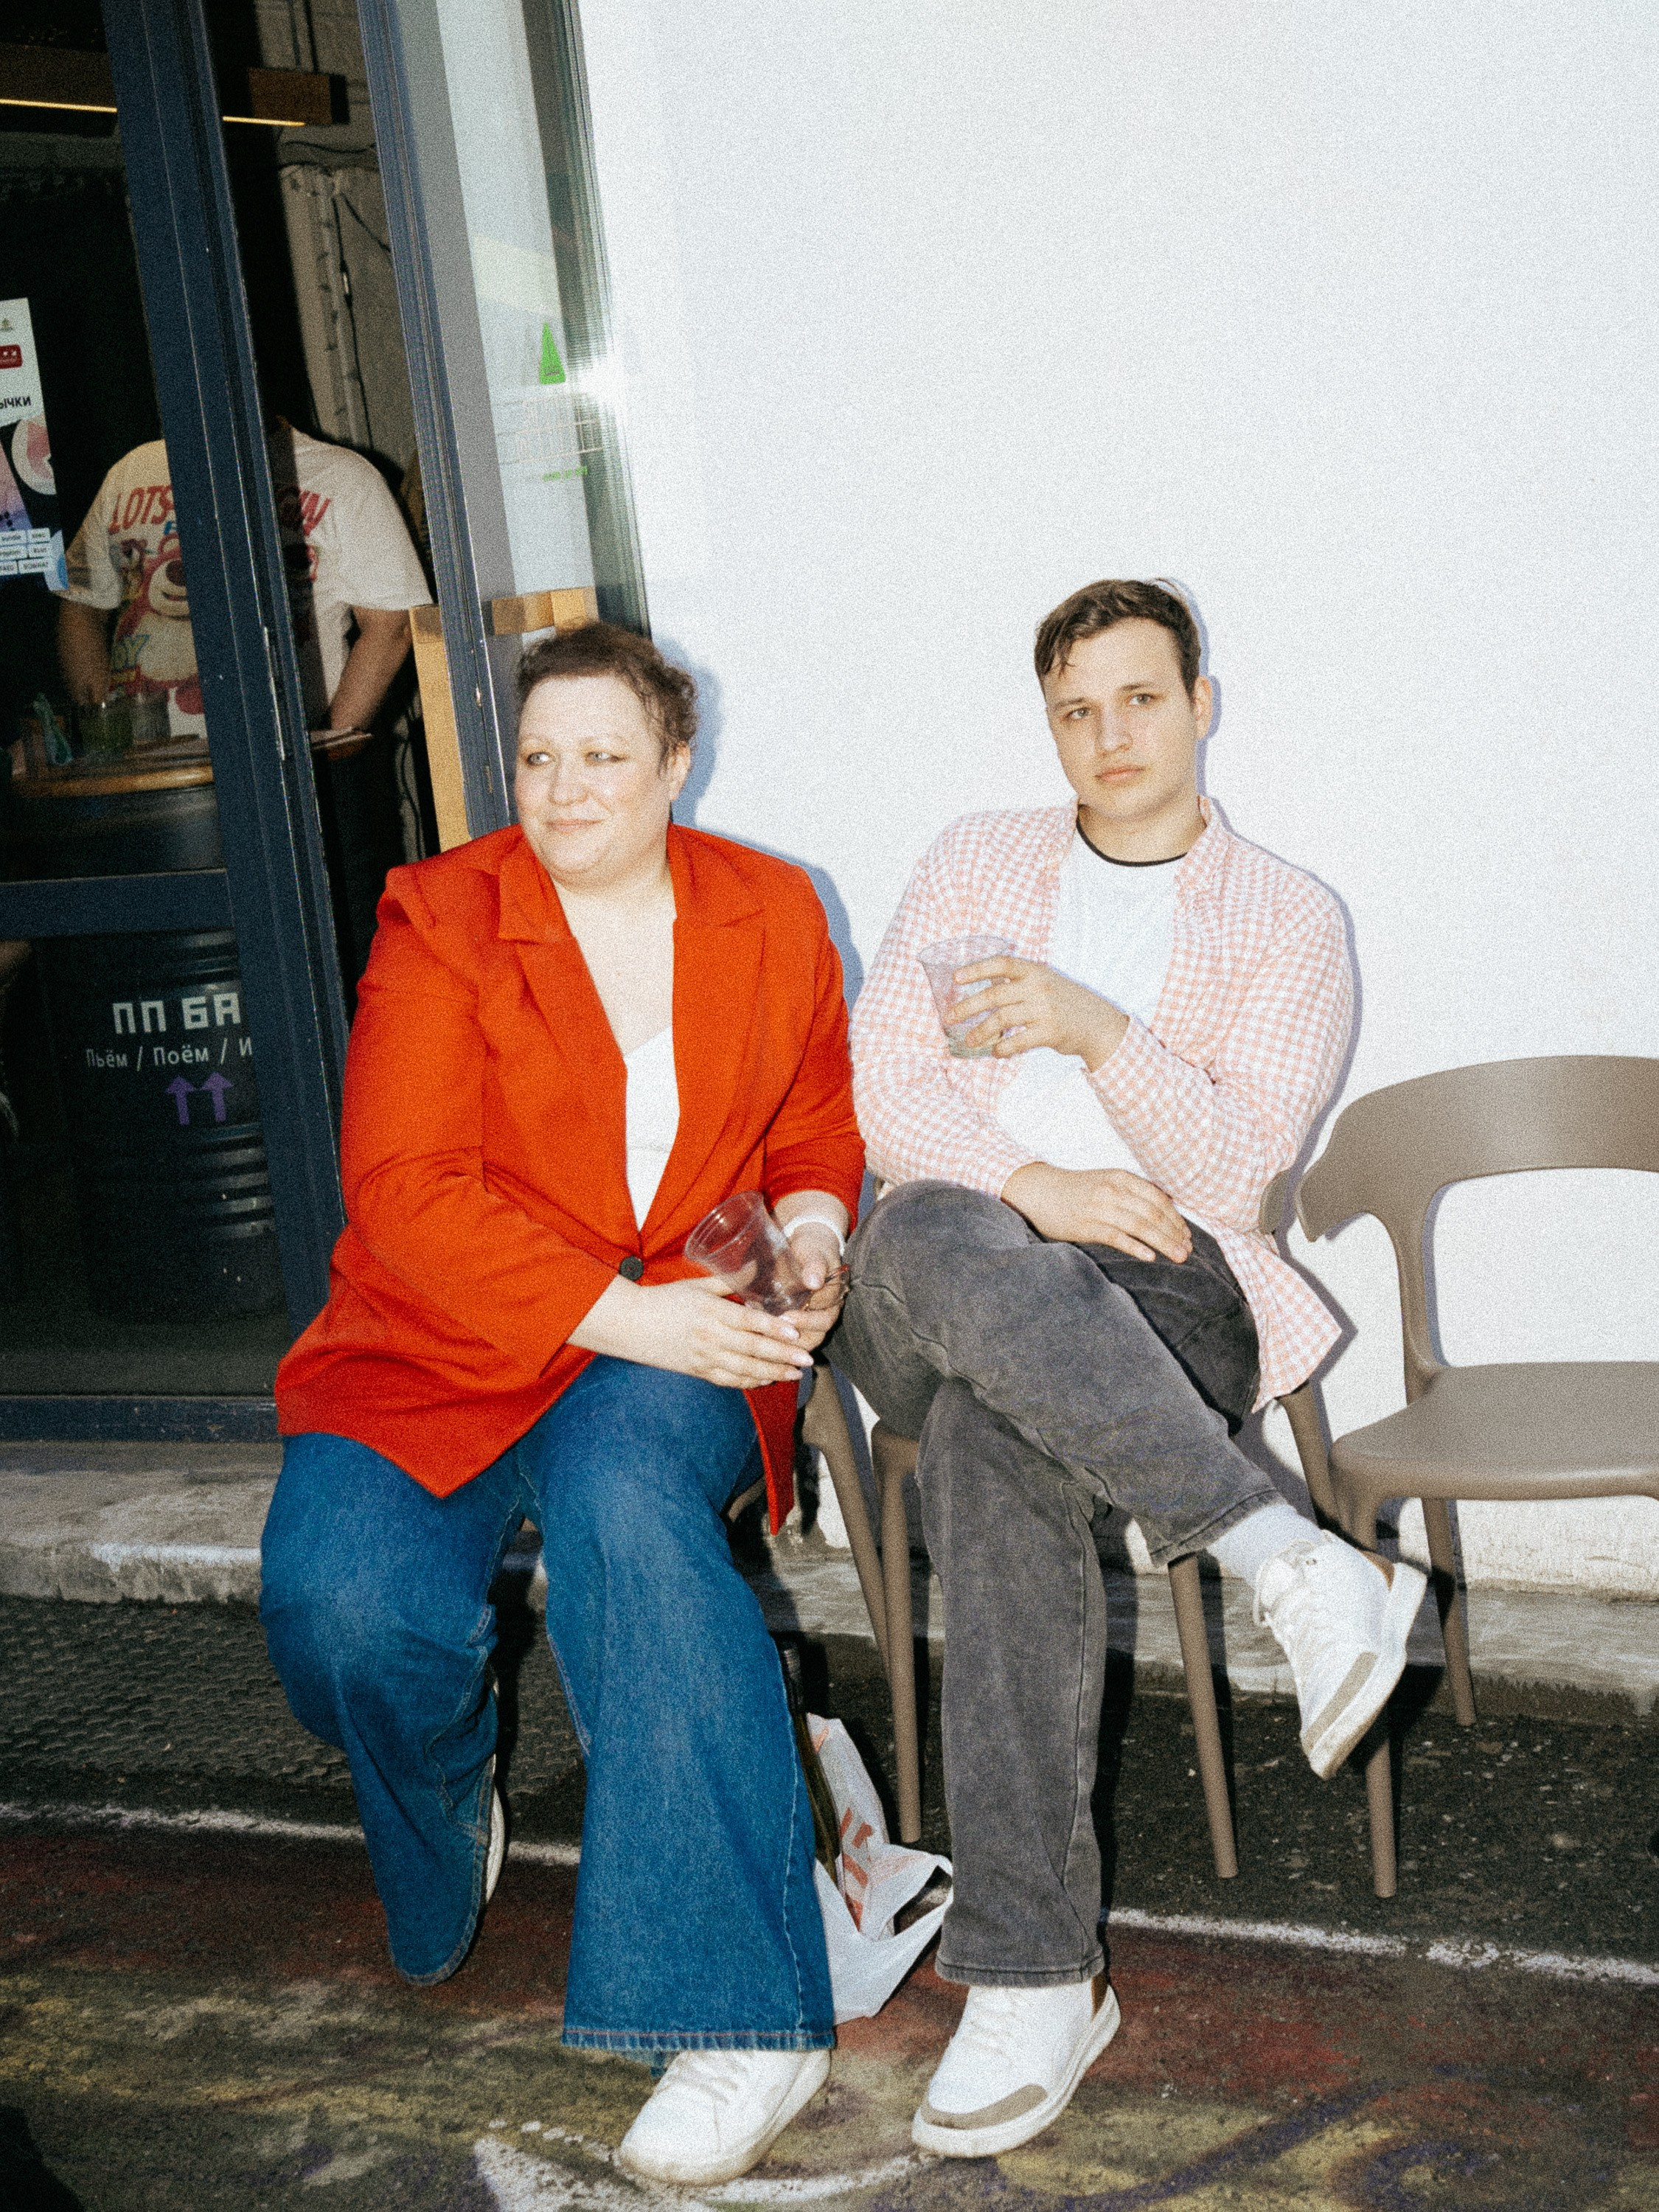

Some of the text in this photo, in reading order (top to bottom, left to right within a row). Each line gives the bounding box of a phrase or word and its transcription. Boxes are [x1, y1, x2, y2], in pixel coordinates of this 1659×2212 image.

[112, 1000, 167, 1034] ПП
[86, 1048, 128, 1068] Пьём
[153, 1044, 209, 1066] Поём
